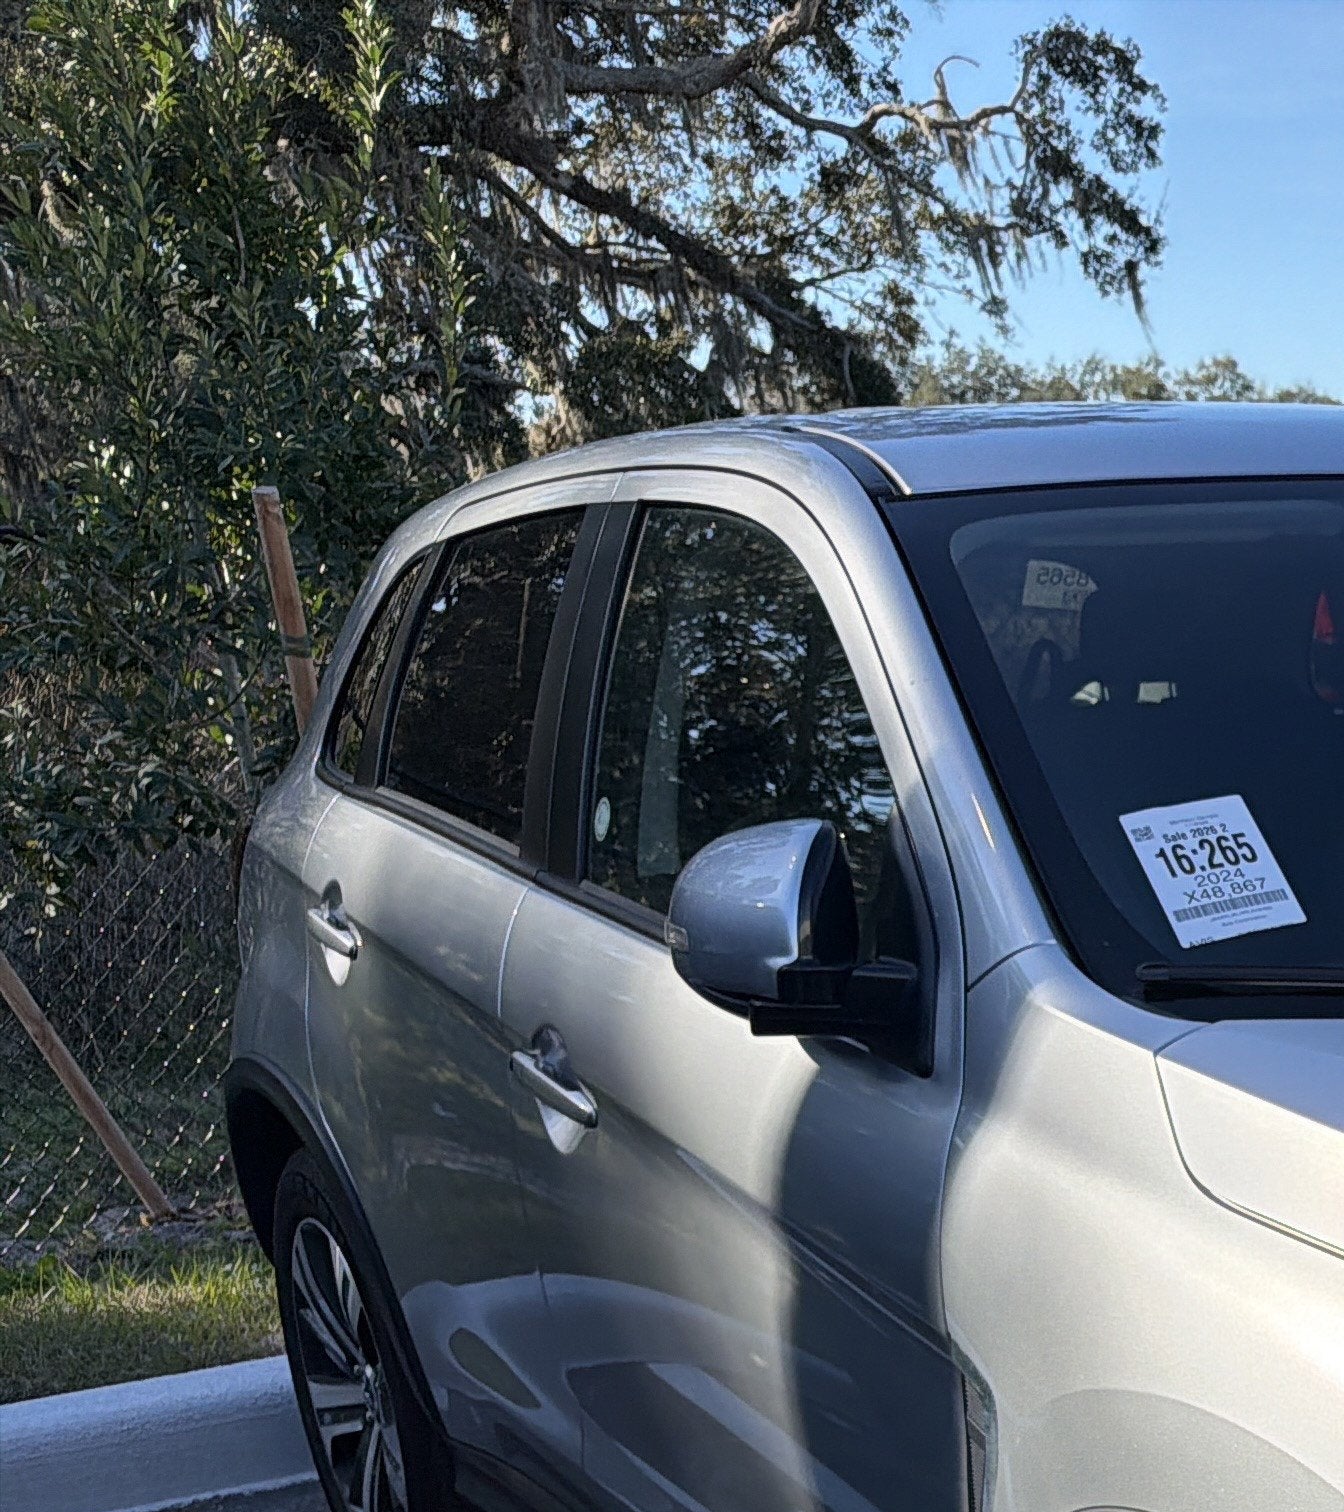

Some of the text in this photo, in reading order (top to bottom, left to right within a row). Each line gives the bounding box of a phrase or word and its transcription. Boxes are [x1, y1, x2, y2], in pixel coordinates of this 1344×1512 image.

[1162, 832, 1189, 843] Sale
[1219, 823, 1229, 832] 2
[1155, 832, 1259, 878] 16:265
[1194, 868, 1246, 888] 2024
[1183, 877, 1266, 905] X48,867
